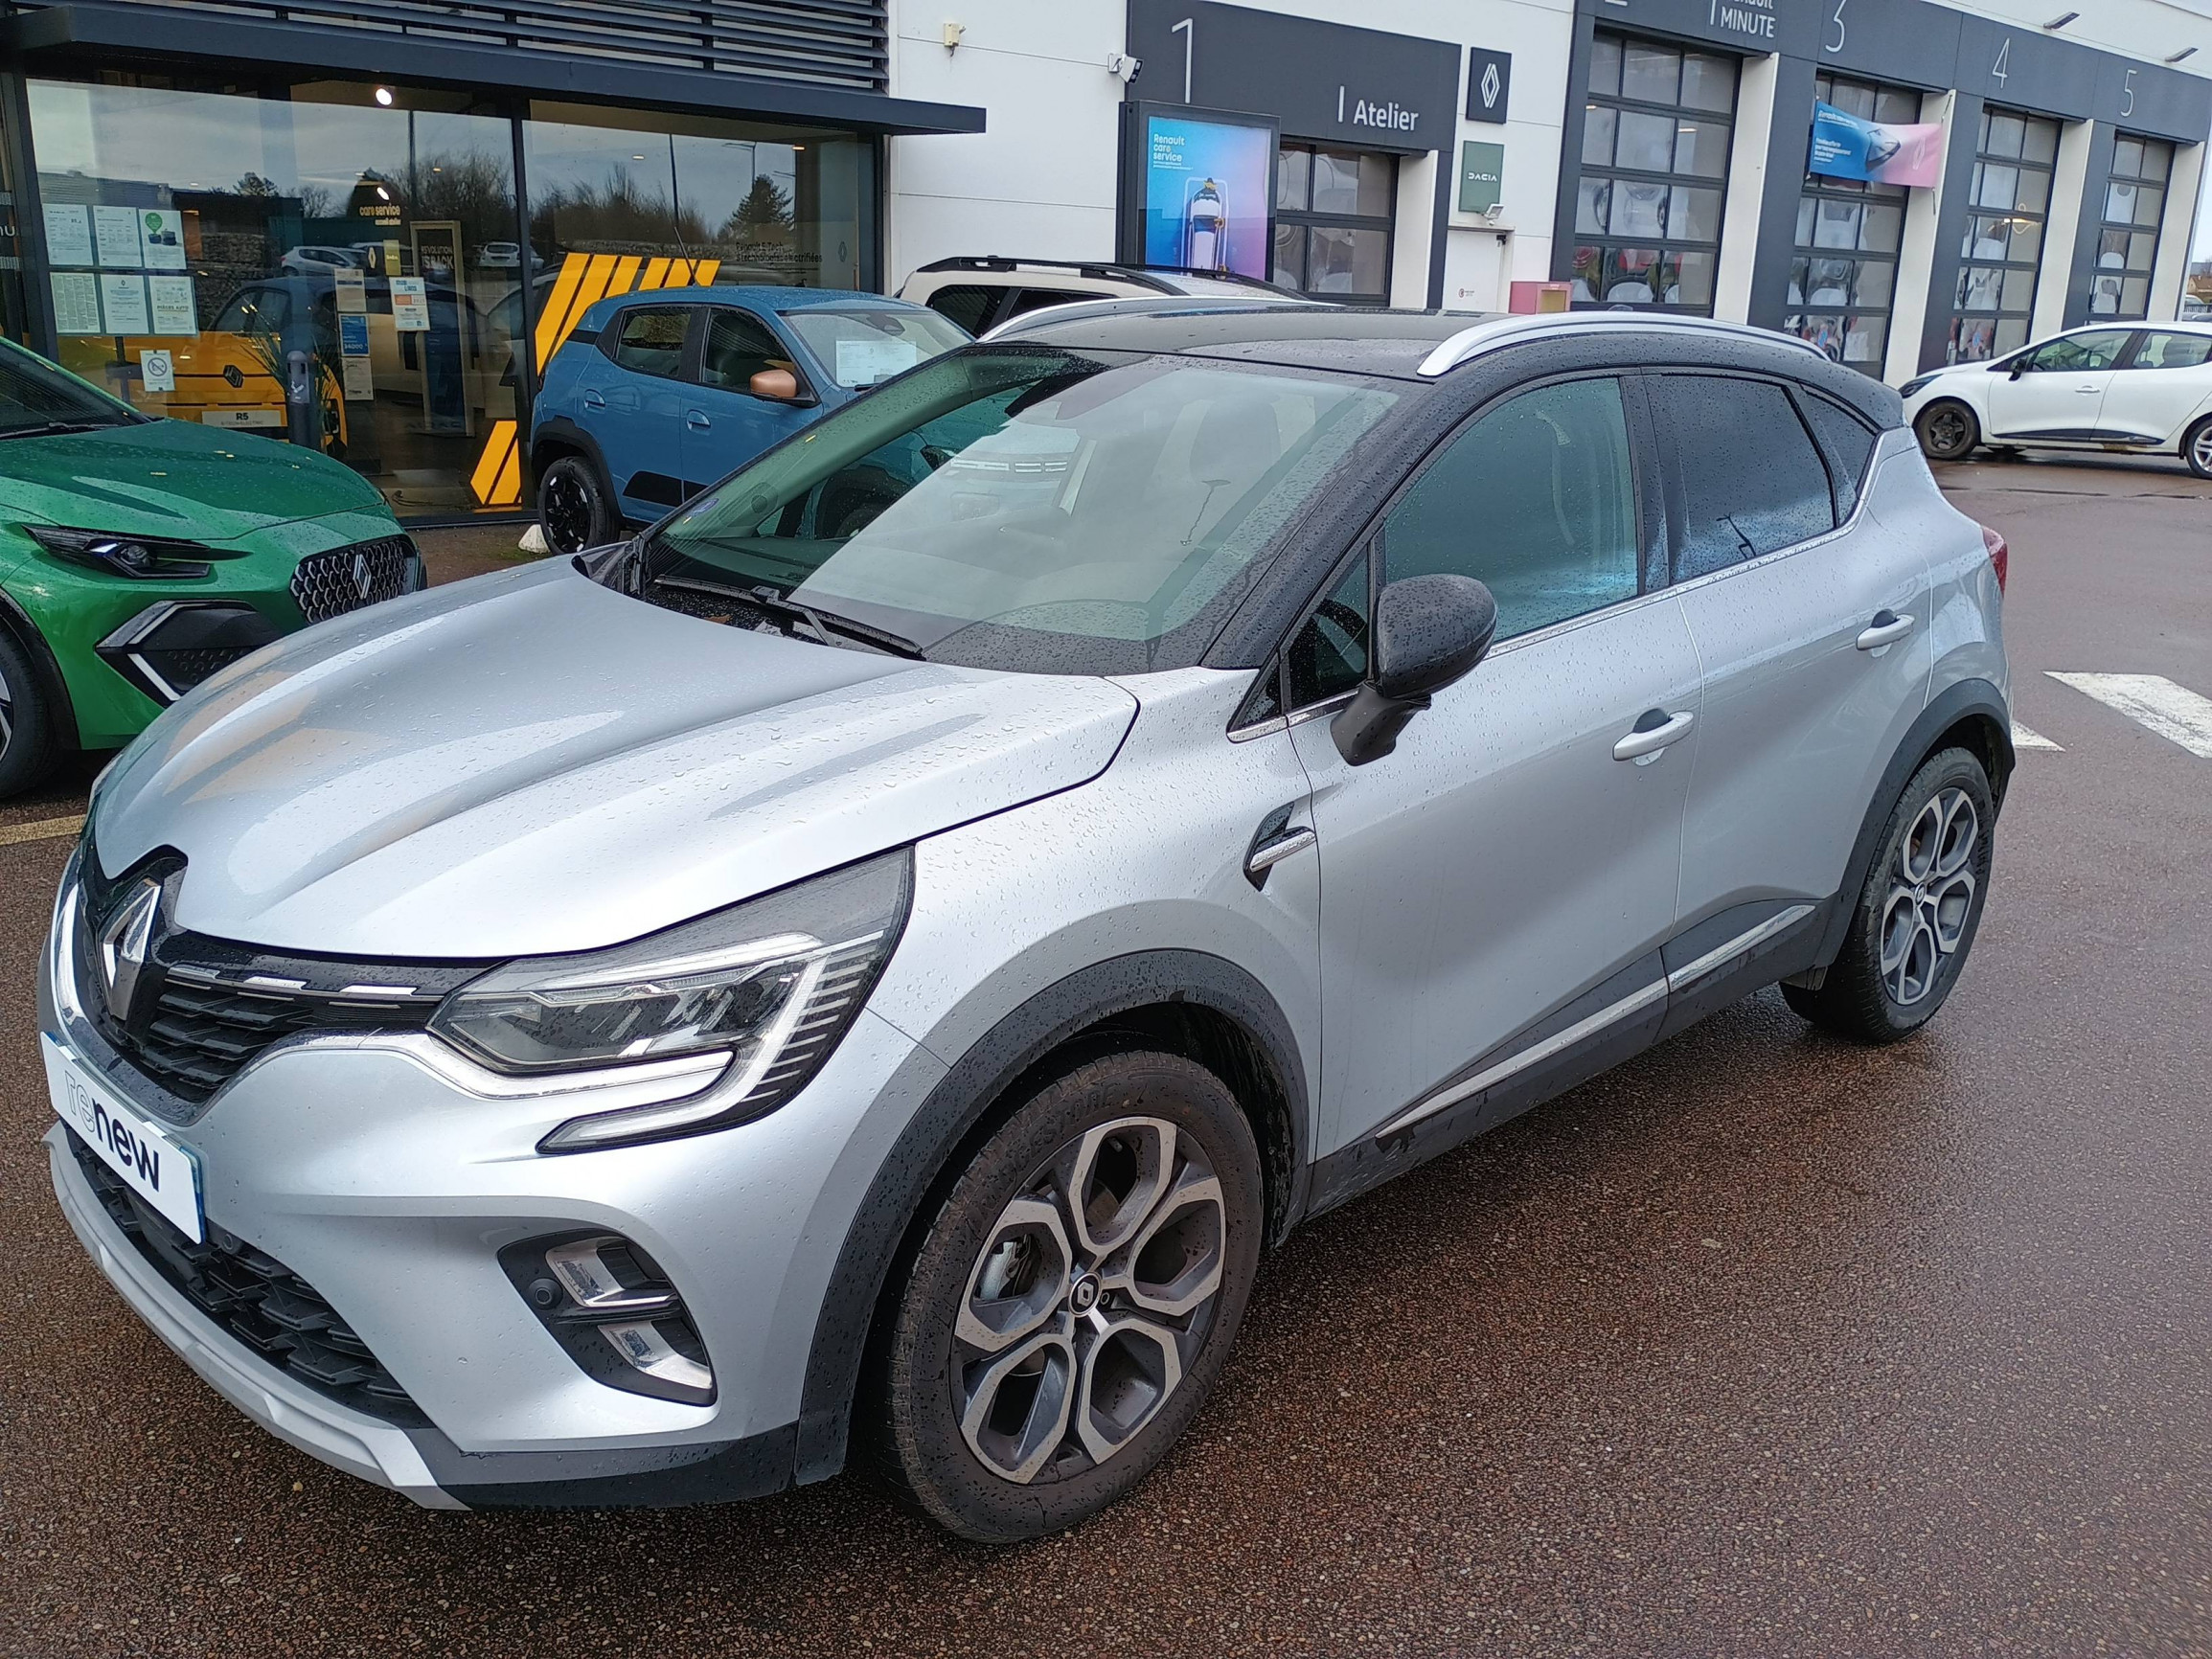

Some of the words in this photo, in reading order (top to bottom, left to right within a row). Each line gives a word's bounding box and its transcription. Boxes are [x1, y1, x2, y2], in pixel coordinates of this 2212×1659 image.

[1720, 6, 1776, 38] MINUTE
[1825, 0, 1846, 53] 3
[1171, 17, 1194, 104] 1
[1992, 37, 2010, 89] 4
[2120, 69, 2137, 117] 5
[1353, 99, 1420, 131] Atelier
[1153, 133, 1185, 146] Renault
[1153, 144, 1171, 153] care
[1153, 152, 1182, 162] service
[1468, 171, 1497, 182] DACIA
[64, 1070, 159, 1193] renew
